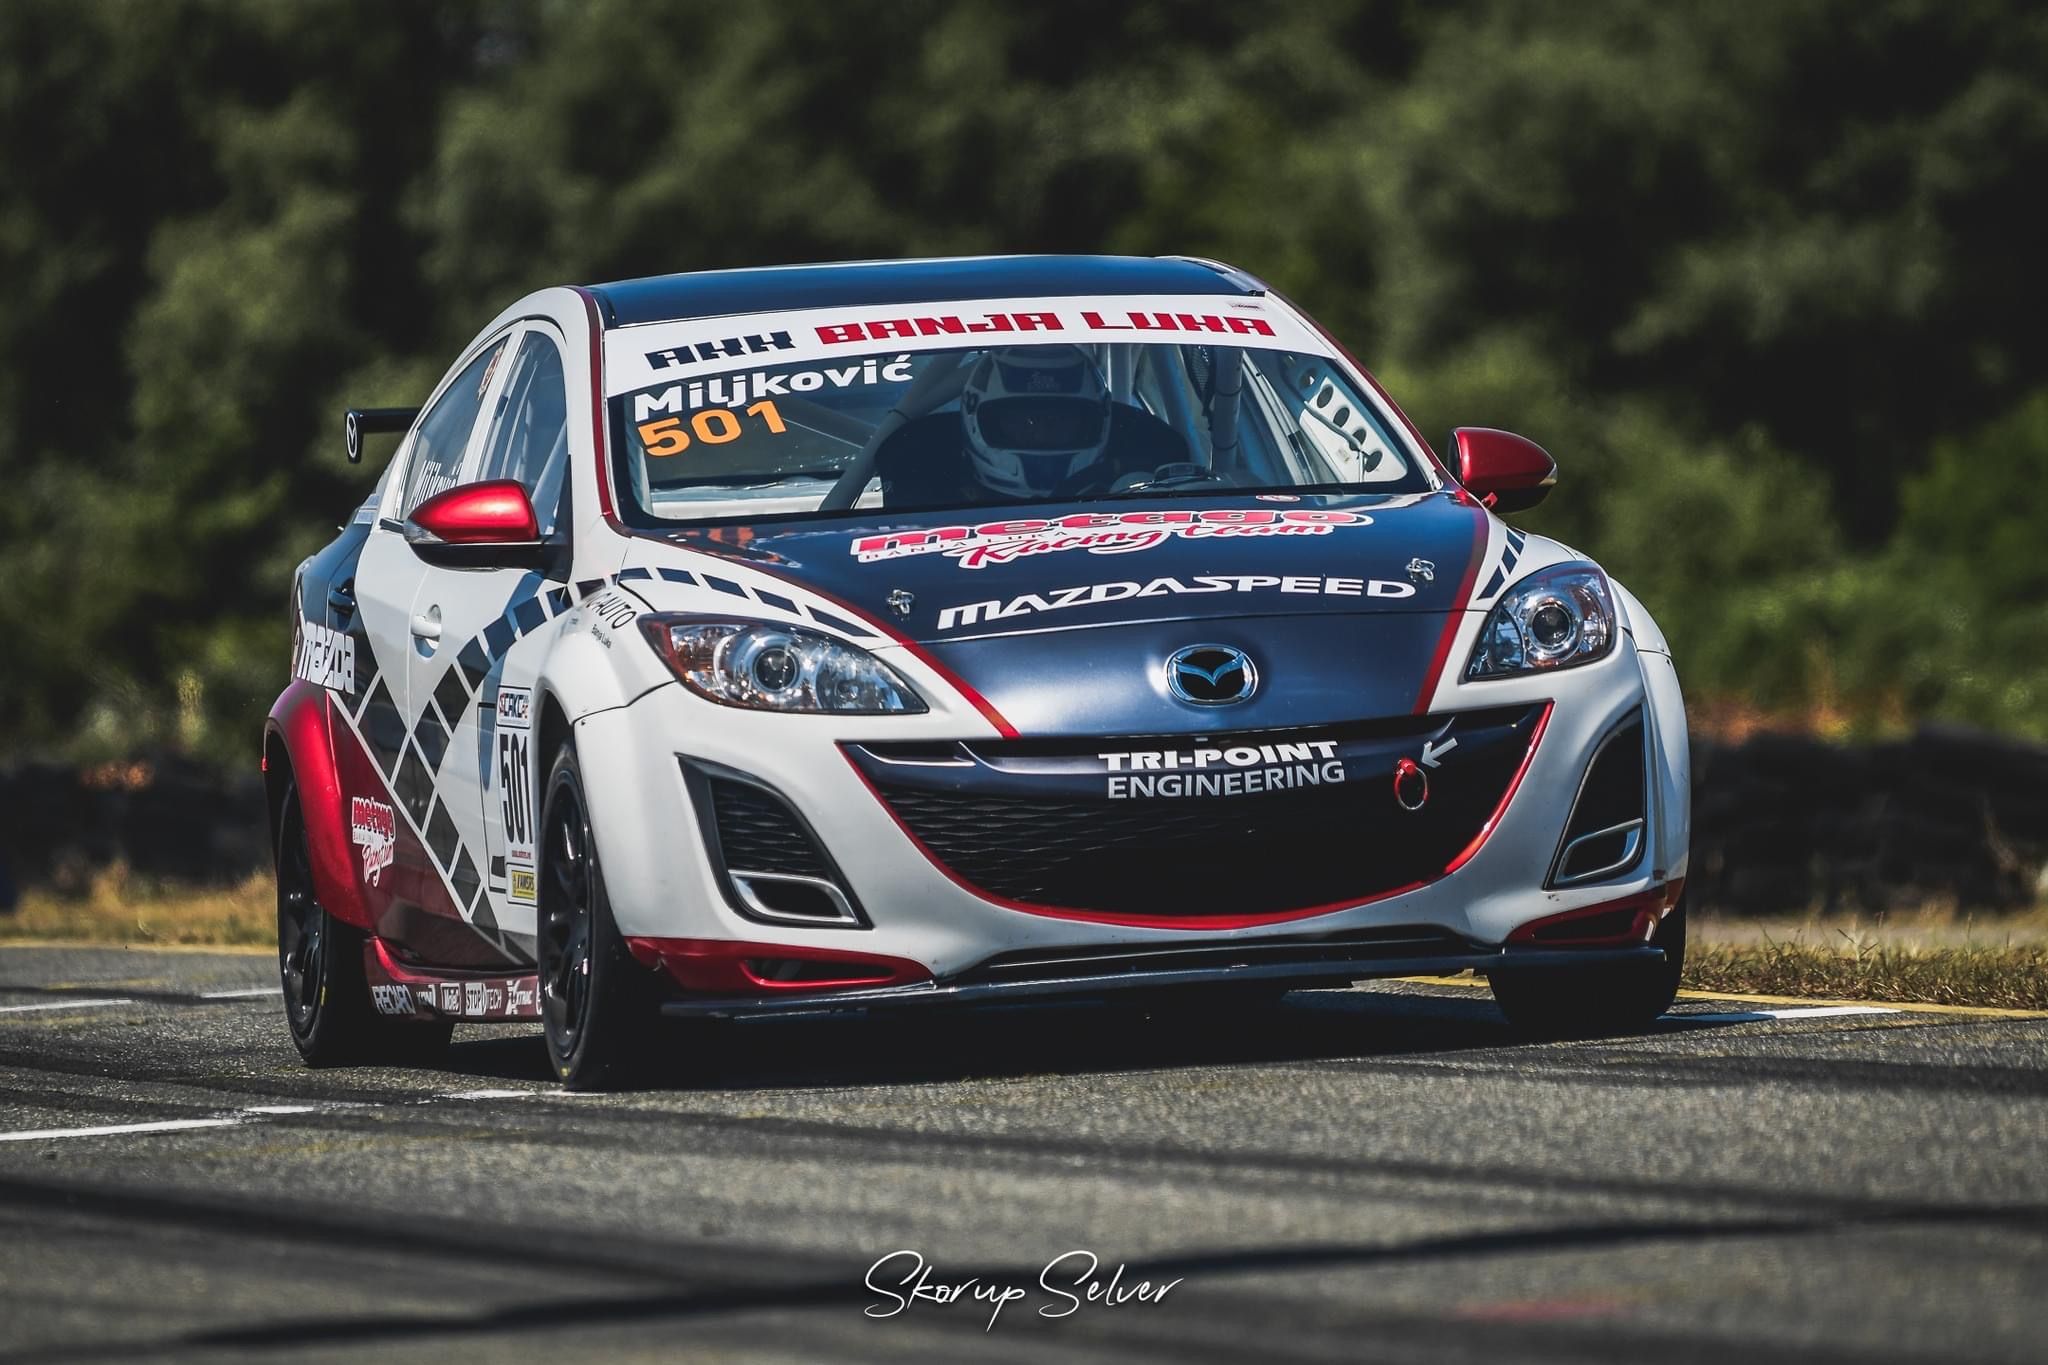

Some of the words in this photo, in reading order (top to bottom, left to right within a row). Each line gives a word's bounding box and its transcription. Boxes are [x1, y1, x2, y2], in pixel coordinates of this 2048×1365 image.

[815, 312, 1064, 345] BANJA
[1080, 311, 1277, 337] LUKA
[634, 354, 913, 422] Miljković
[638, 400, 787, 457] 501
[852, 511, 1371, 552] metago
[951, 528, 1164, 566] Racing
[938, 575, 1416, 630] MAZDASPEED
[1098, 741, 1338, 772] TRI-POINT
[500, 733, 533, 845] 501
[1107, 760, 1346, 799] ENGINEERING
